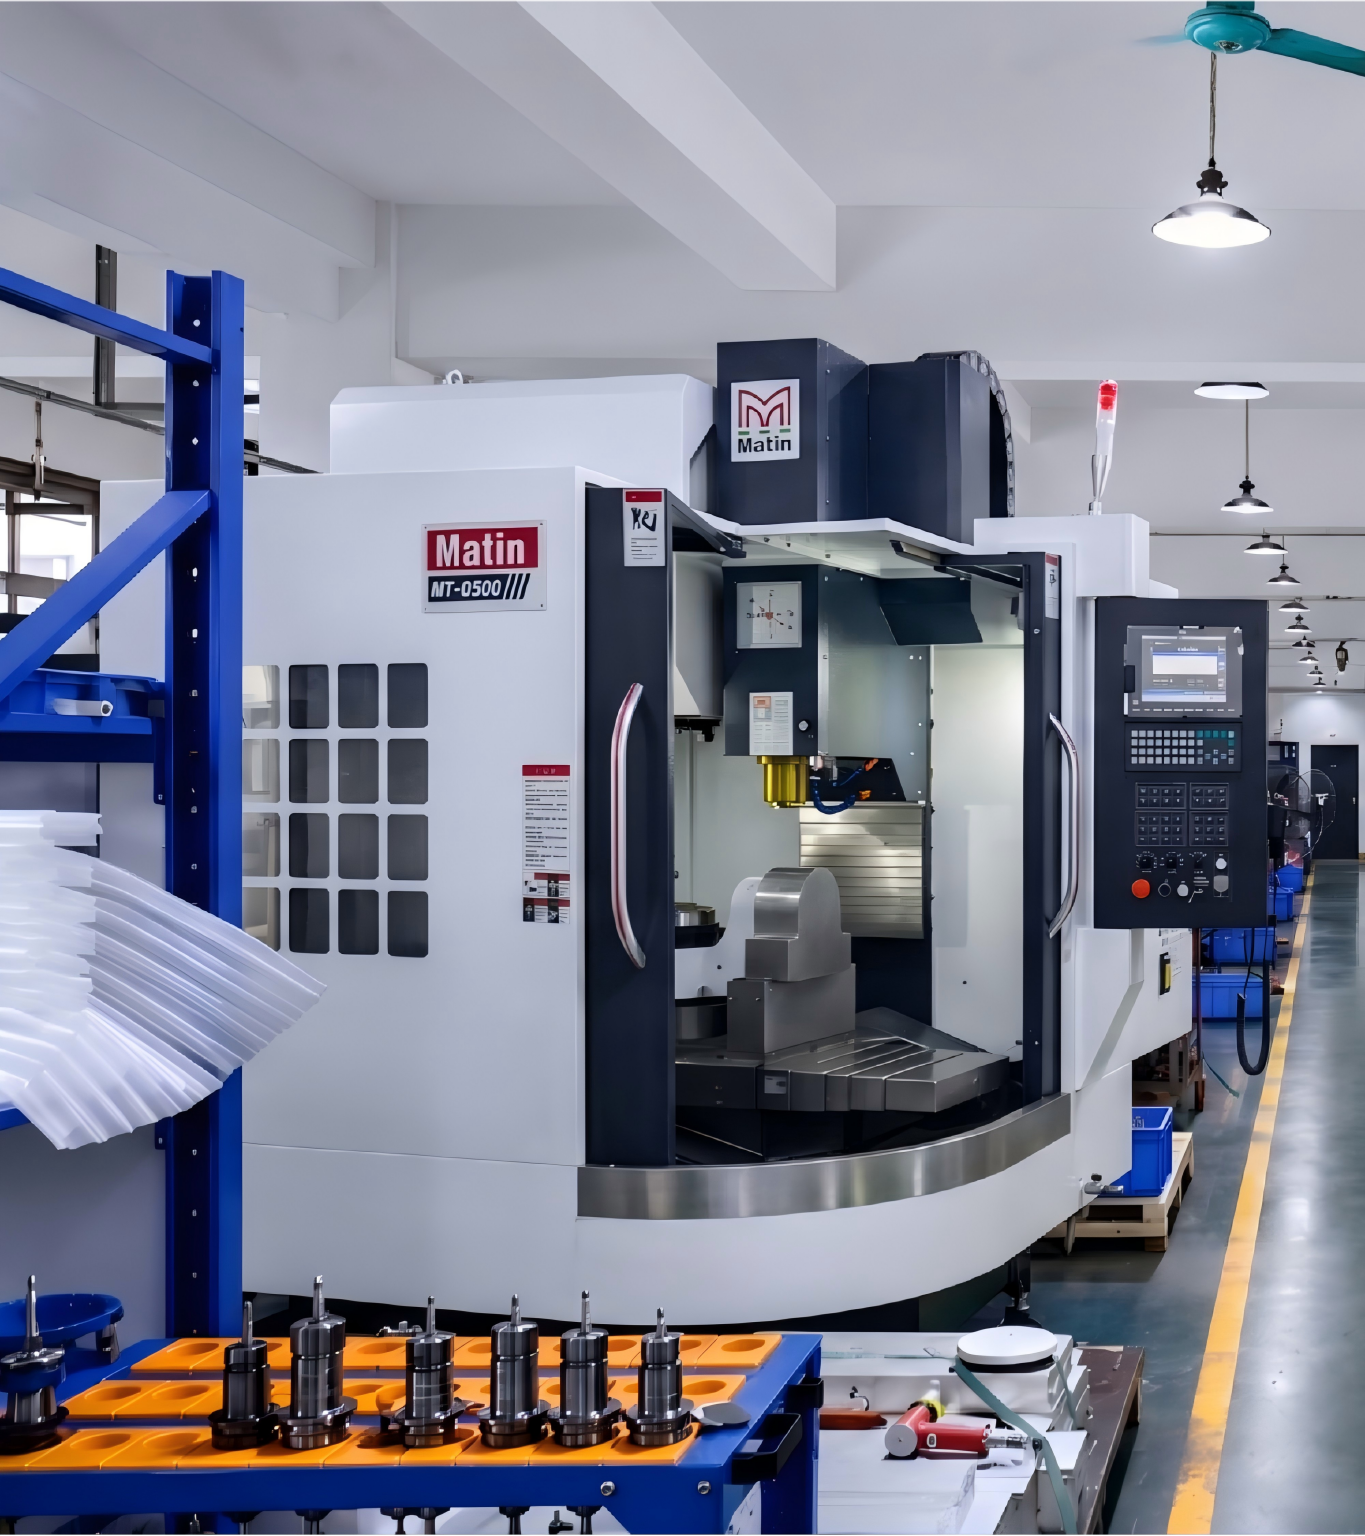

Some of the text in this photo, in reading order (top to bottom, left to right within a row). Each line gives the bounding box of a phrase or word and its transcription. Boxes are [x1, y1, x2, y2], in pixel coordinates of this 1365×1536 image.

[738, 436, 791, 453] Matin
[436, 532, 525, 567] Matin
[431, 579, 502, 598] MT-0500
